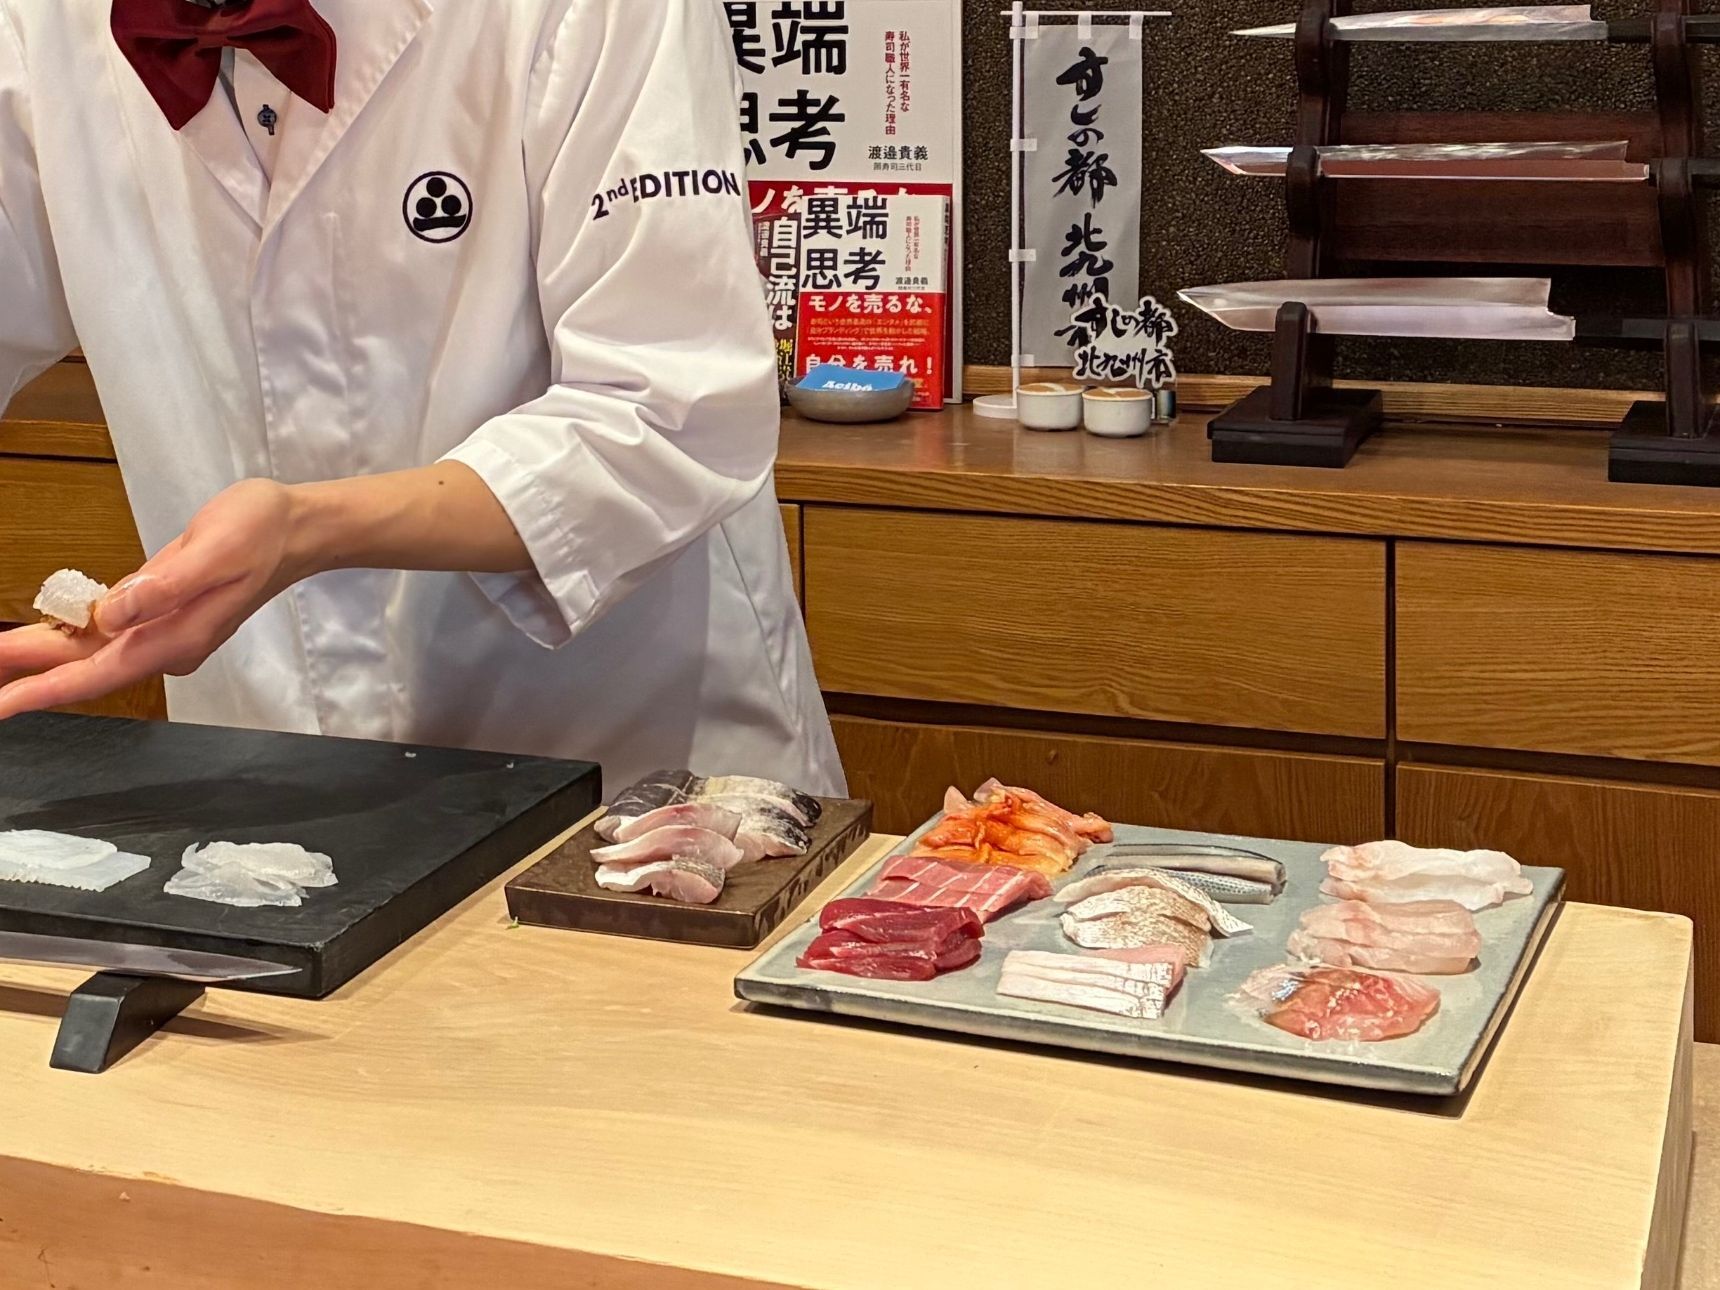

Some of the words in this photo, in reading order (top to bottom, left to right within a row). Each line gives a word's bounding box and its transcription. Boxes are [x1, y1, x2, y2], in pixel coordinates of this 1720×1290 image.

[884, 30, 896, 136] 寿司職人になった理由
[900, 30, 911, 112] 私が世界一有名な
[1052, 46, 1118, 209] すしの都
[591, 178, 629, 220] 2nd
[630, 169, 741, 203] EDITION
[803, 195, 889, 240] 異端
[767, 216, 799, 331] 自己流は
[802, 247, 886, 291] 思考
[808, 294, 933, 314] モノを売るな、
[1075, 296, 1174, 348] すしの都
[1076, 345, 1172, 382] 北九州市
